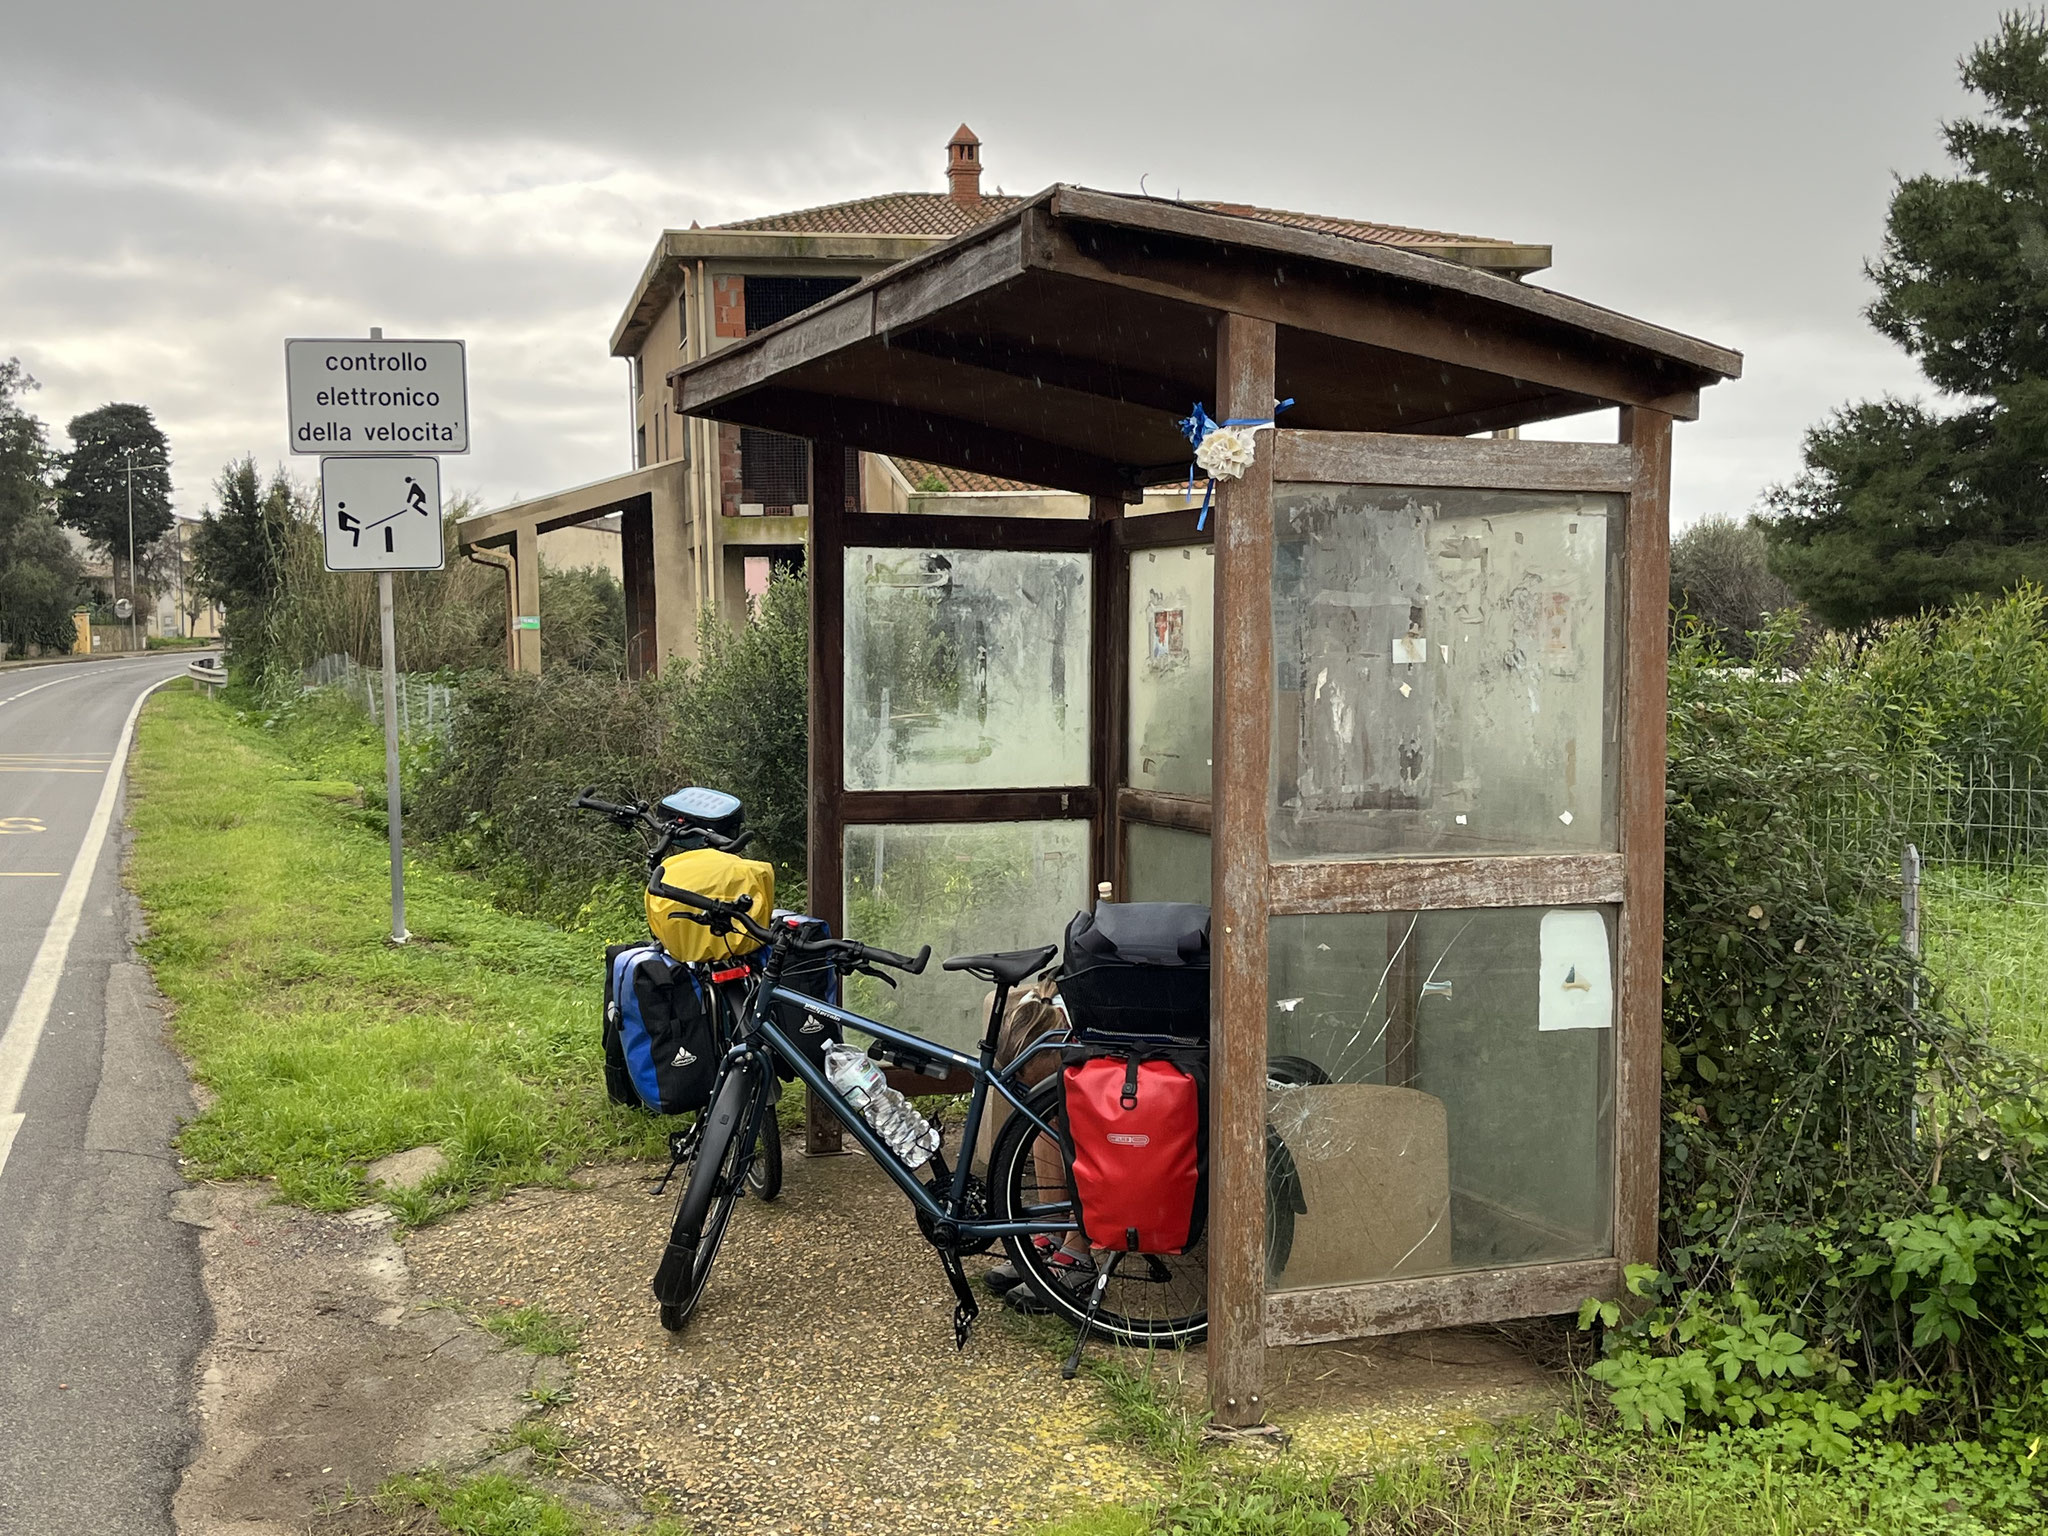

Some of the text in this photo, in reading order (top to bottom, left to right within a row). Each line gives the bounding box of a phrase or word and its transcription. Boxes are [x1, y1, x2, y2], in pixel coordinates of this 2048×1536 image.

[325, 351, 427, 371] controllo
[316, 387, 440, 406] elettronico
[297, 421, 459, 441] della velocita'
